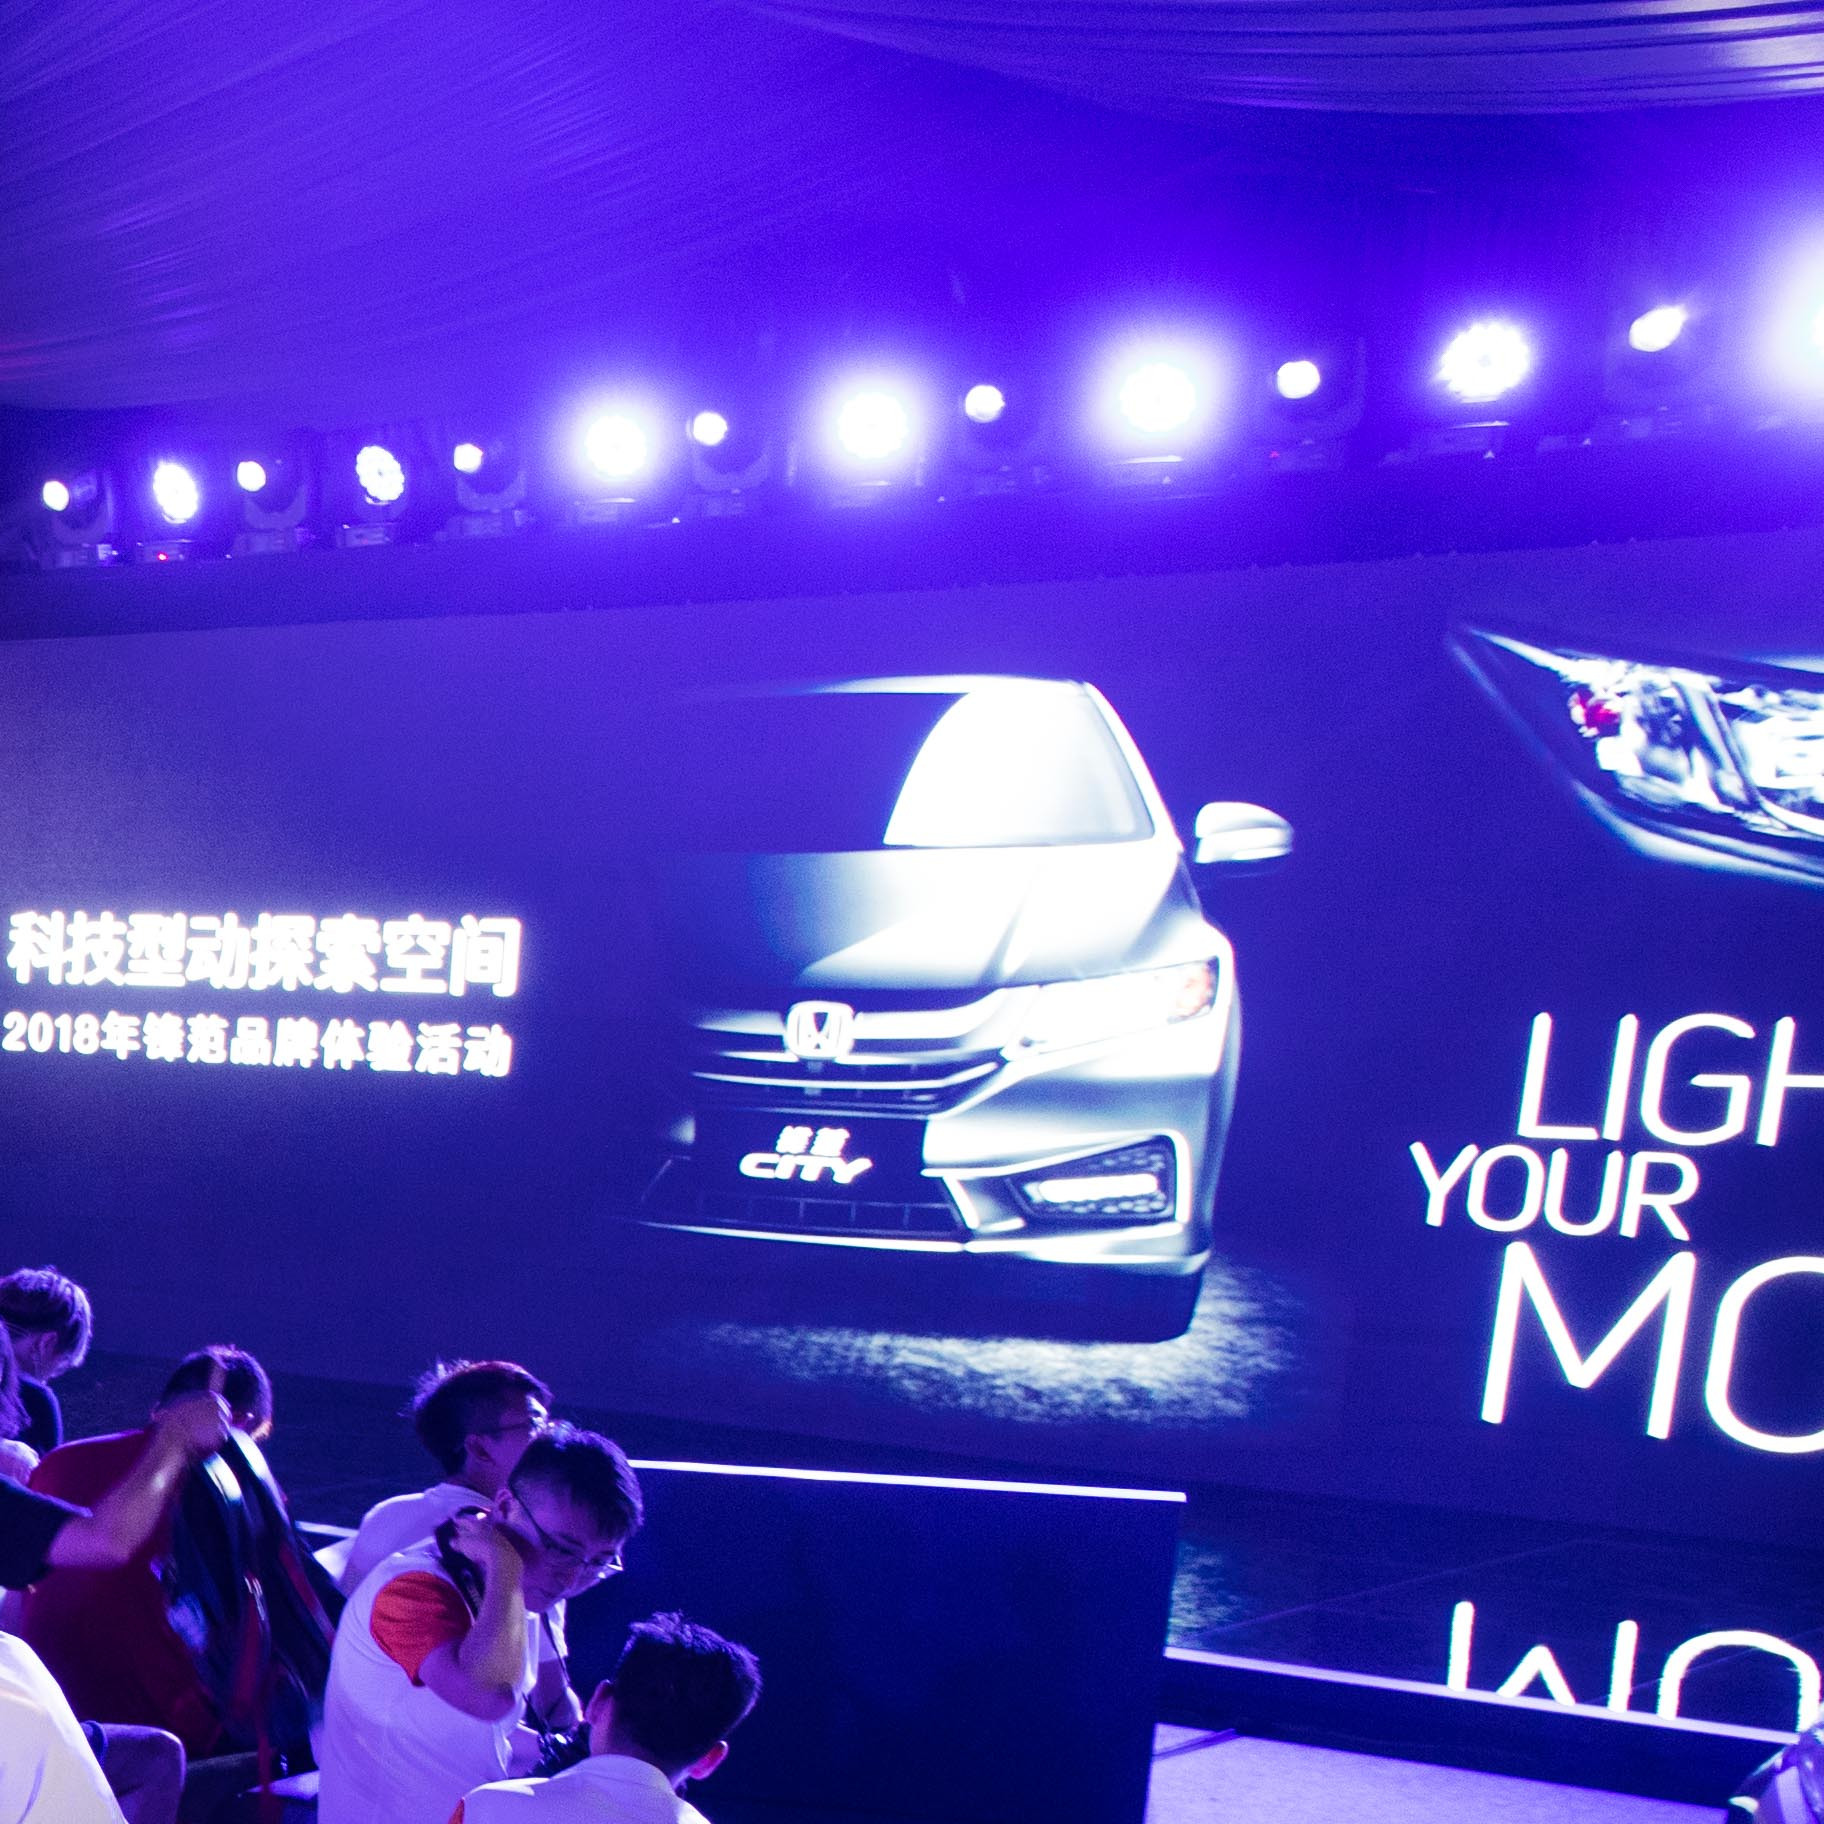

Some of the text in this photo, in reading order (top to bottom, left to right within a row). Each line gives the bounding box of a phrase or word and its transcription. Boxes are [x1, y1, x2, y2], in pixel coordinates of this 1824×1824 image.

[6, 910, 524, 997] 科技型动探索空间
[1, 1010, 514, 1077] 2018年锋范品牌体验活动
[739, 1152, 873, 1184] CITY
[1409, 1141, 1700, 1241] YOUR
